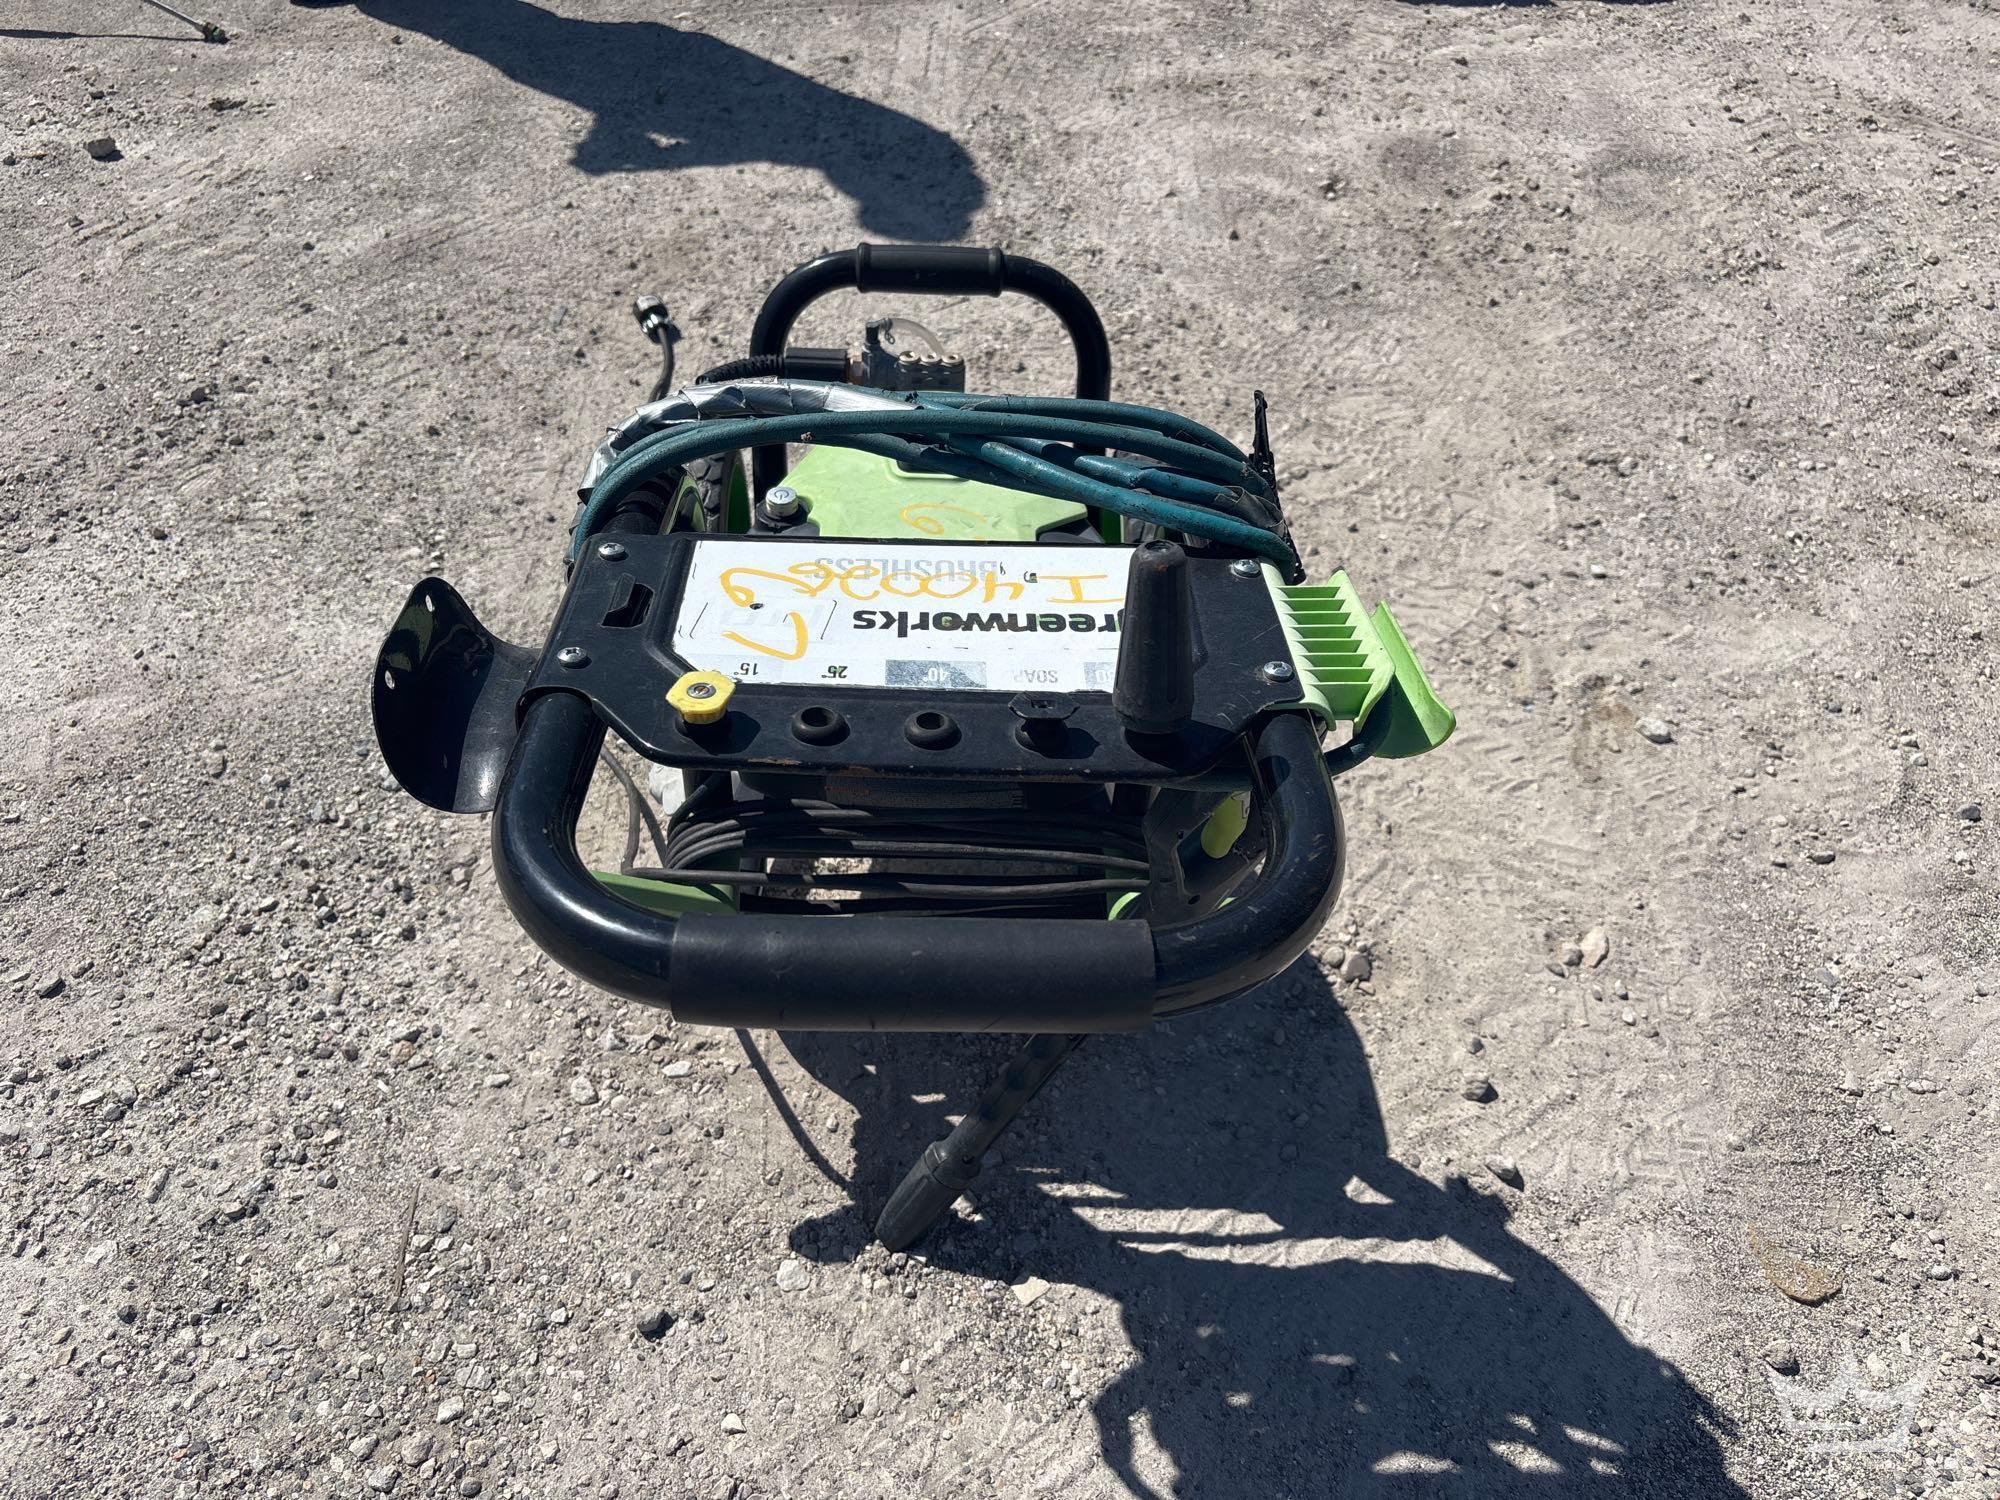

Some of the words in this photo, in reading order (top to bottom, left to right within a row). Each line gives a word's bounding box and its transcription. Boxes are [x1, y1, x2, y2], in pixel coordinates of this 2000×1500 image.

[815, 558, 999, 583] BRUSHLESS
[733, 662, 759, 676] 15°
[821, 665, 848, 679] 25°
